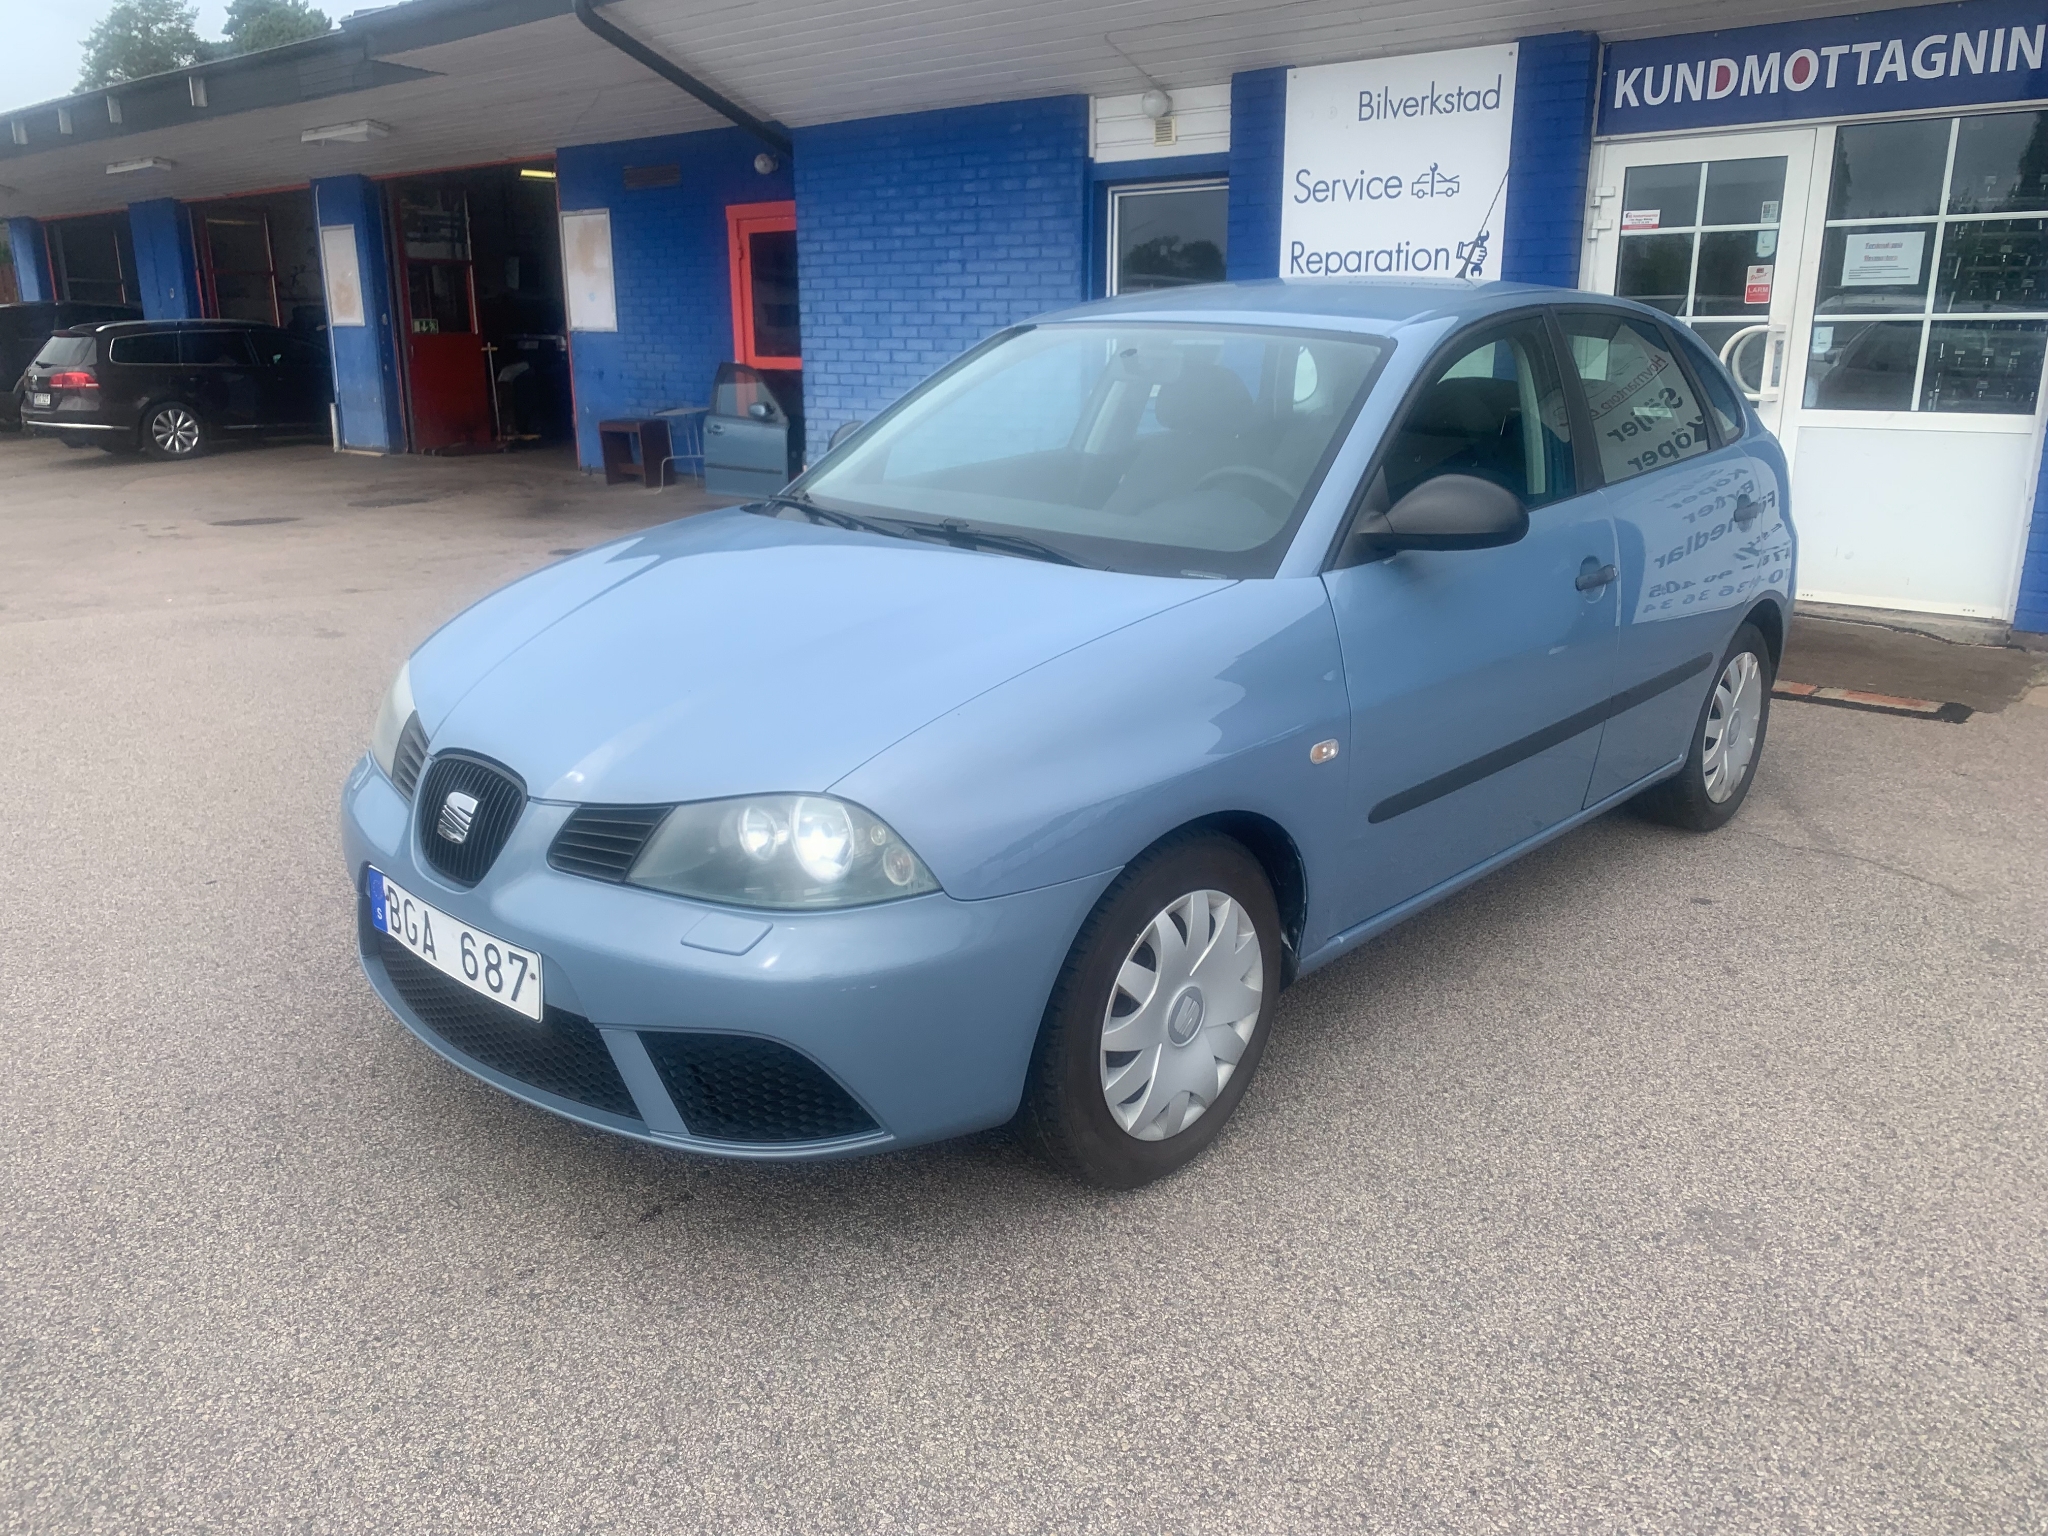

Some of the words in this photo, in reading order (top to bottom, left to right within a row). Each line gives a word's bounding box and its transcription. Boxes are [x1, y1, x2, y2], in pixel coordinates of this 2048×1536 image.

[1613, 24, 2047, 109] KUNDMOTTAGNIN
[1358, 73, 1502, 122] Bilverkstad
[1294, 168, 1403, 204] Service
[1290, 240, 1450, 276] Reparation
[1748, 286, 1769, 294] LARM
[387, 884, 438, 961] BGA
[460, 931, 529, 1002] 687
